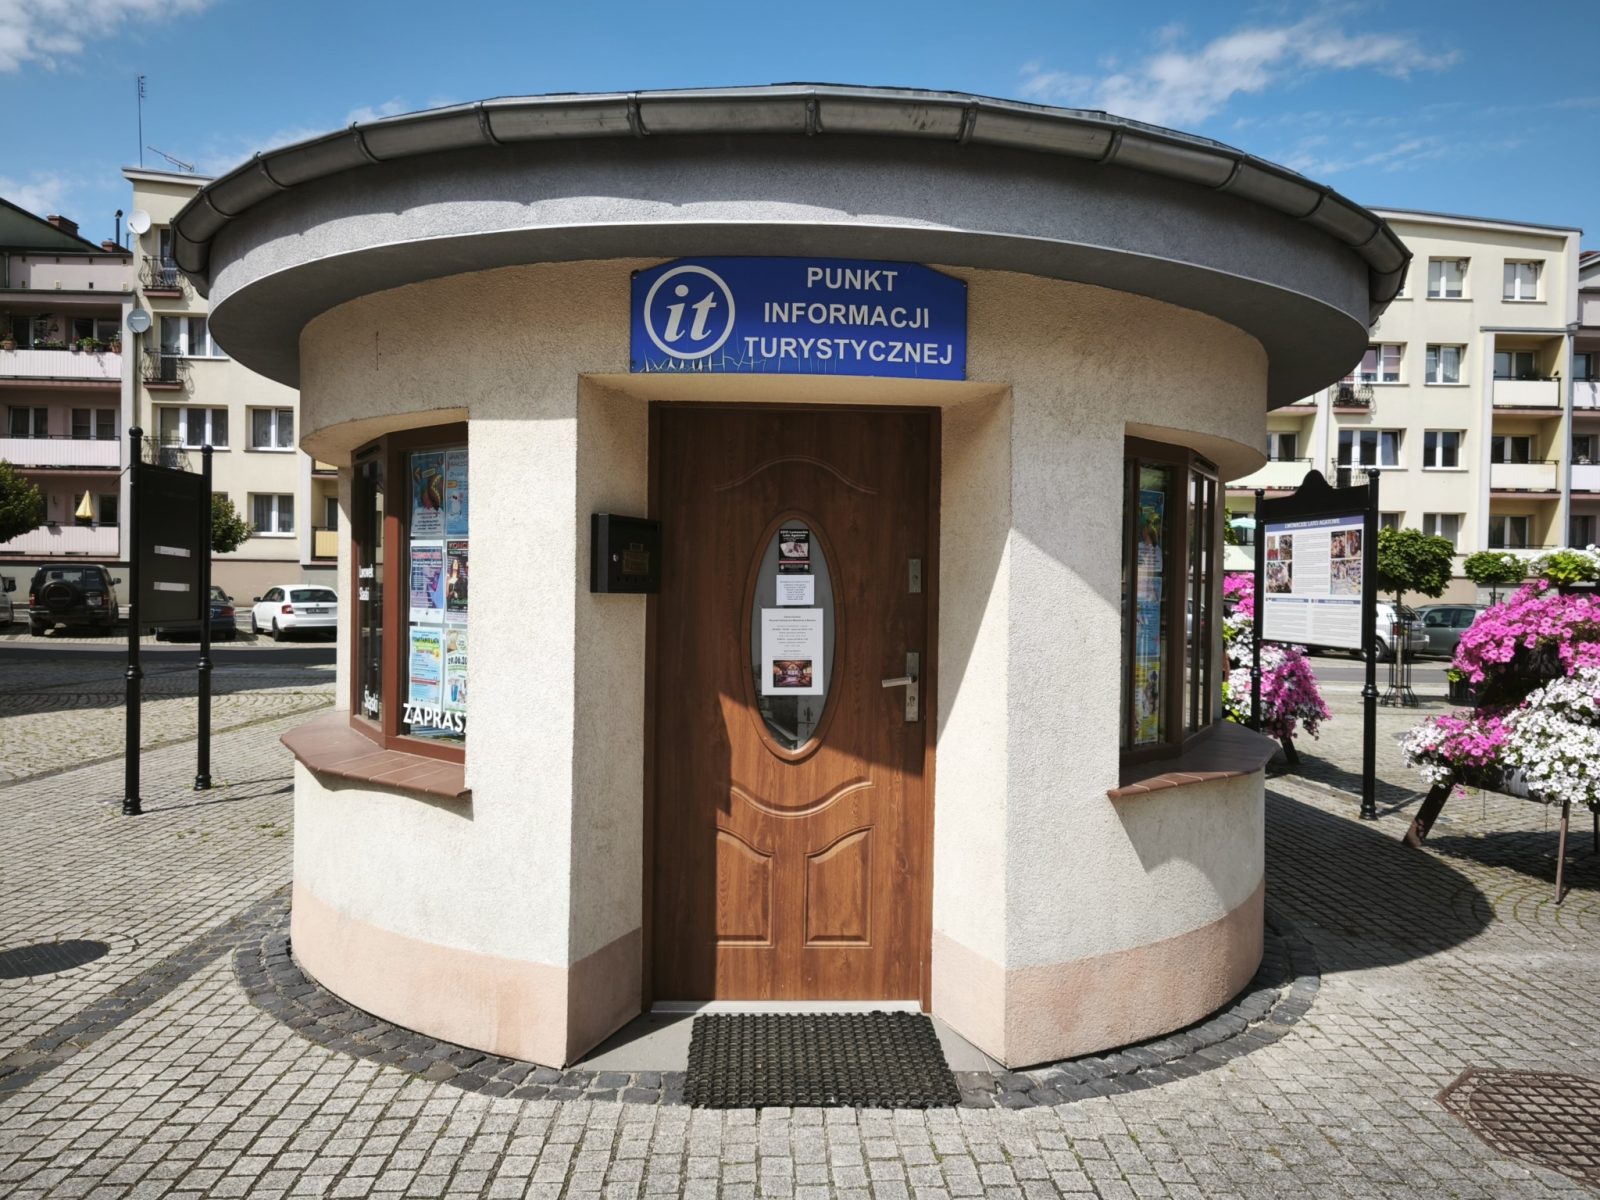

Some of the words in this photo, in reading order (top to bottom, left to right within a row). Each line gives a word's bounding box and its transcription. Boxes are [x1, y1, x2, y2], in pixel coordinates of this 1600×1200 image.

[807, 267, 898, 292] PUNKT
[664, 284, 717, 342] it
[764, 302, 929, 328] INFORMACJI
[744, 336, 953, 365] TURYSTYCZNEJ
